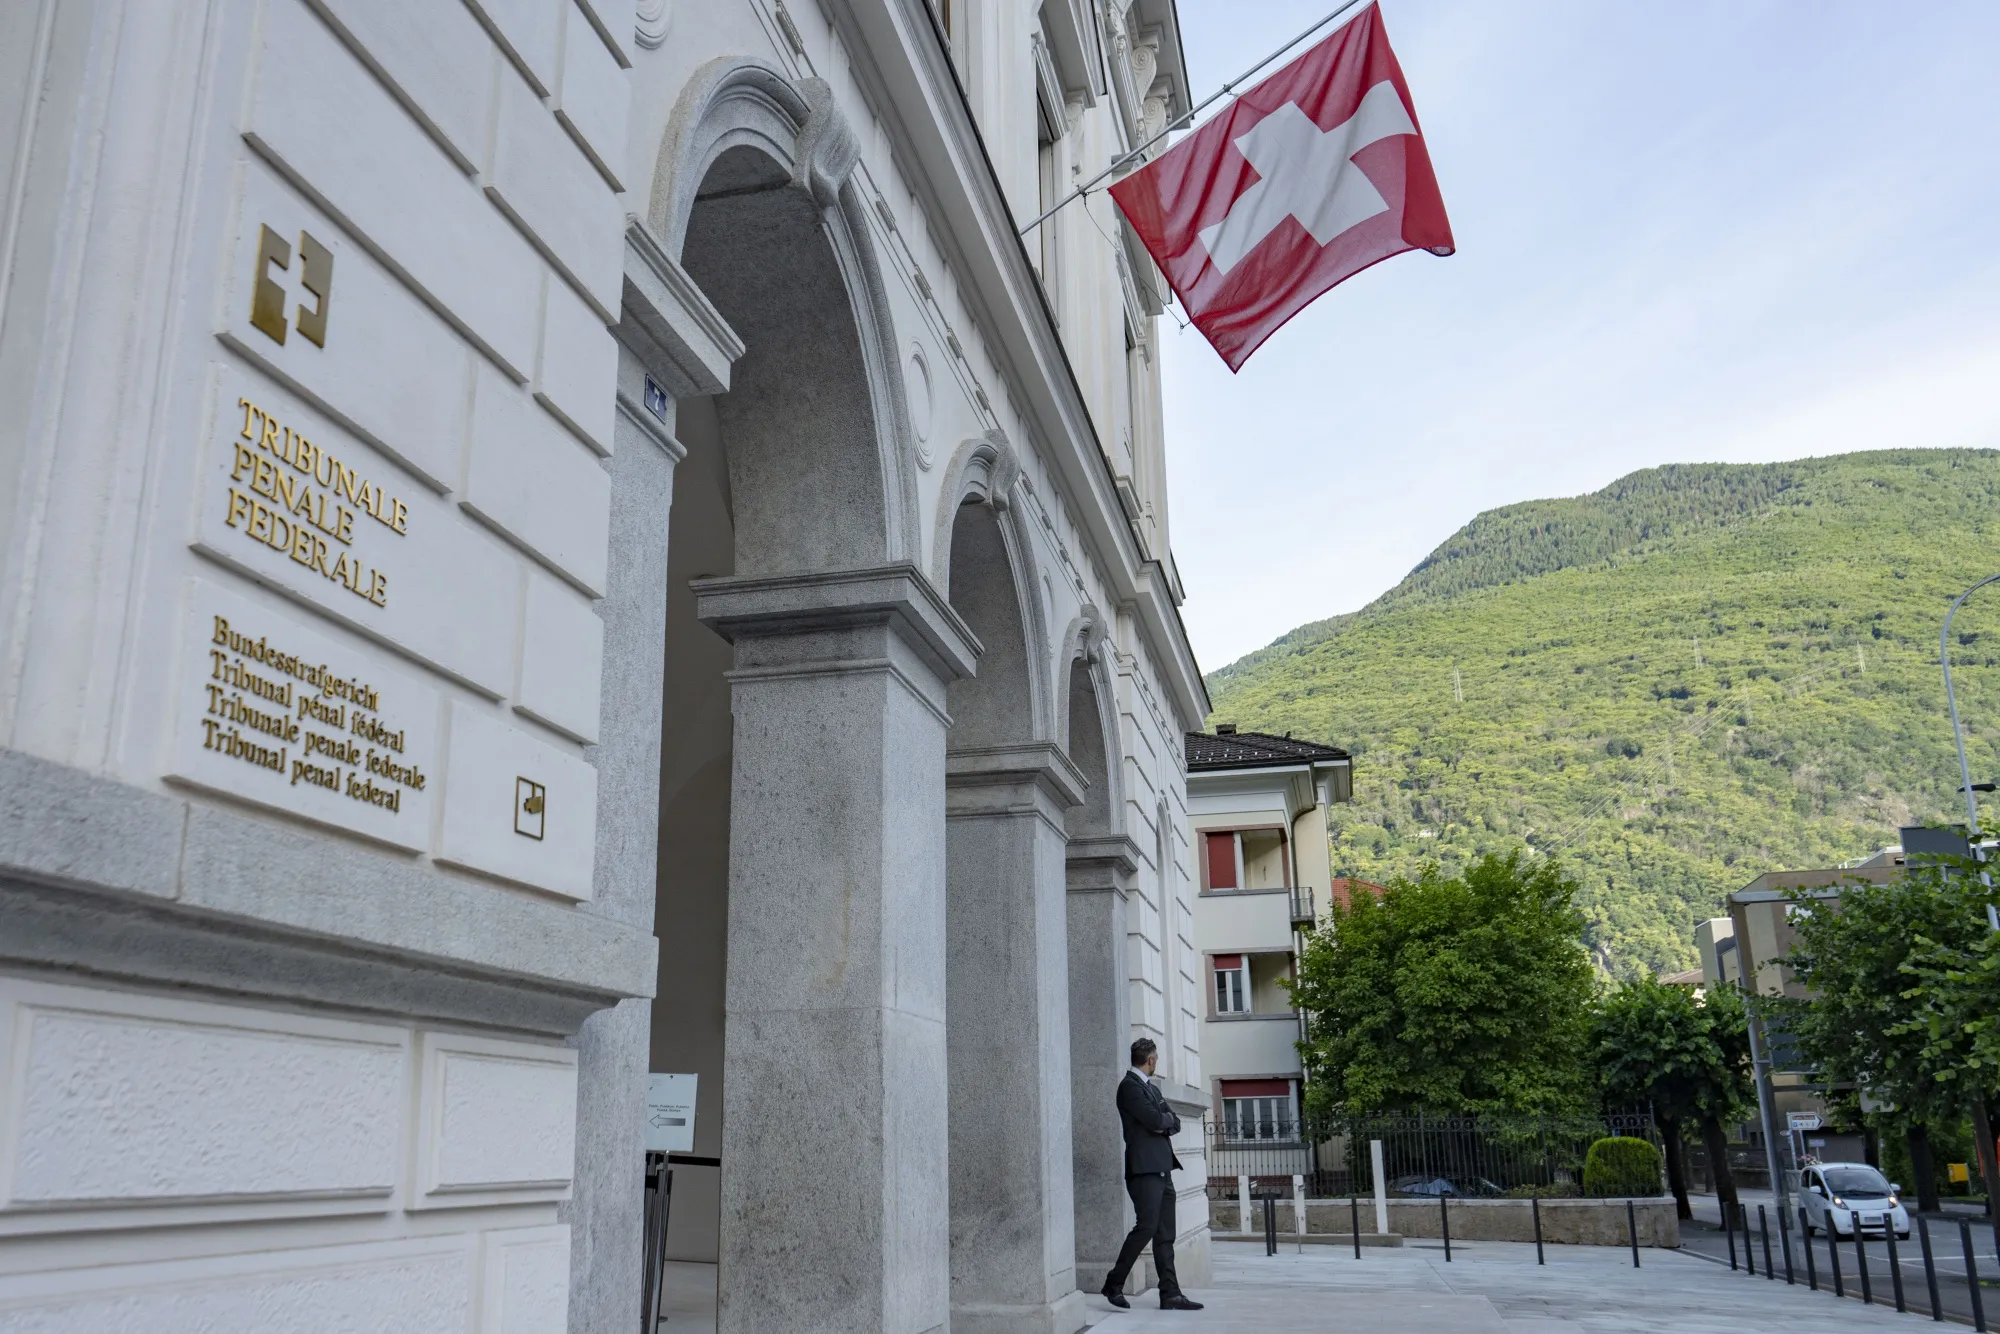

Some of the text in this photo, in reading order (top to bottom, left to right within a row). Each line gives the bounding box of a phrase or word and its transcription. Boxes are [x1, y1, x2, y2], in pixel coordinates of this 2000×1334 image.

[231, 442, 354, 545] PENALE
[239, 397, 408, 535] TRIBUNALE
[225, 487, 388, 608] FEDERALE
[209, 649, 404, 753] Tribunal pénal fédéral
[212, 616, 379, 712] Bundesstrafgericht
[202, 718, 400, 813] Tribunal penal federal
[205, 683, 426, 791] Tribunale penale federale
